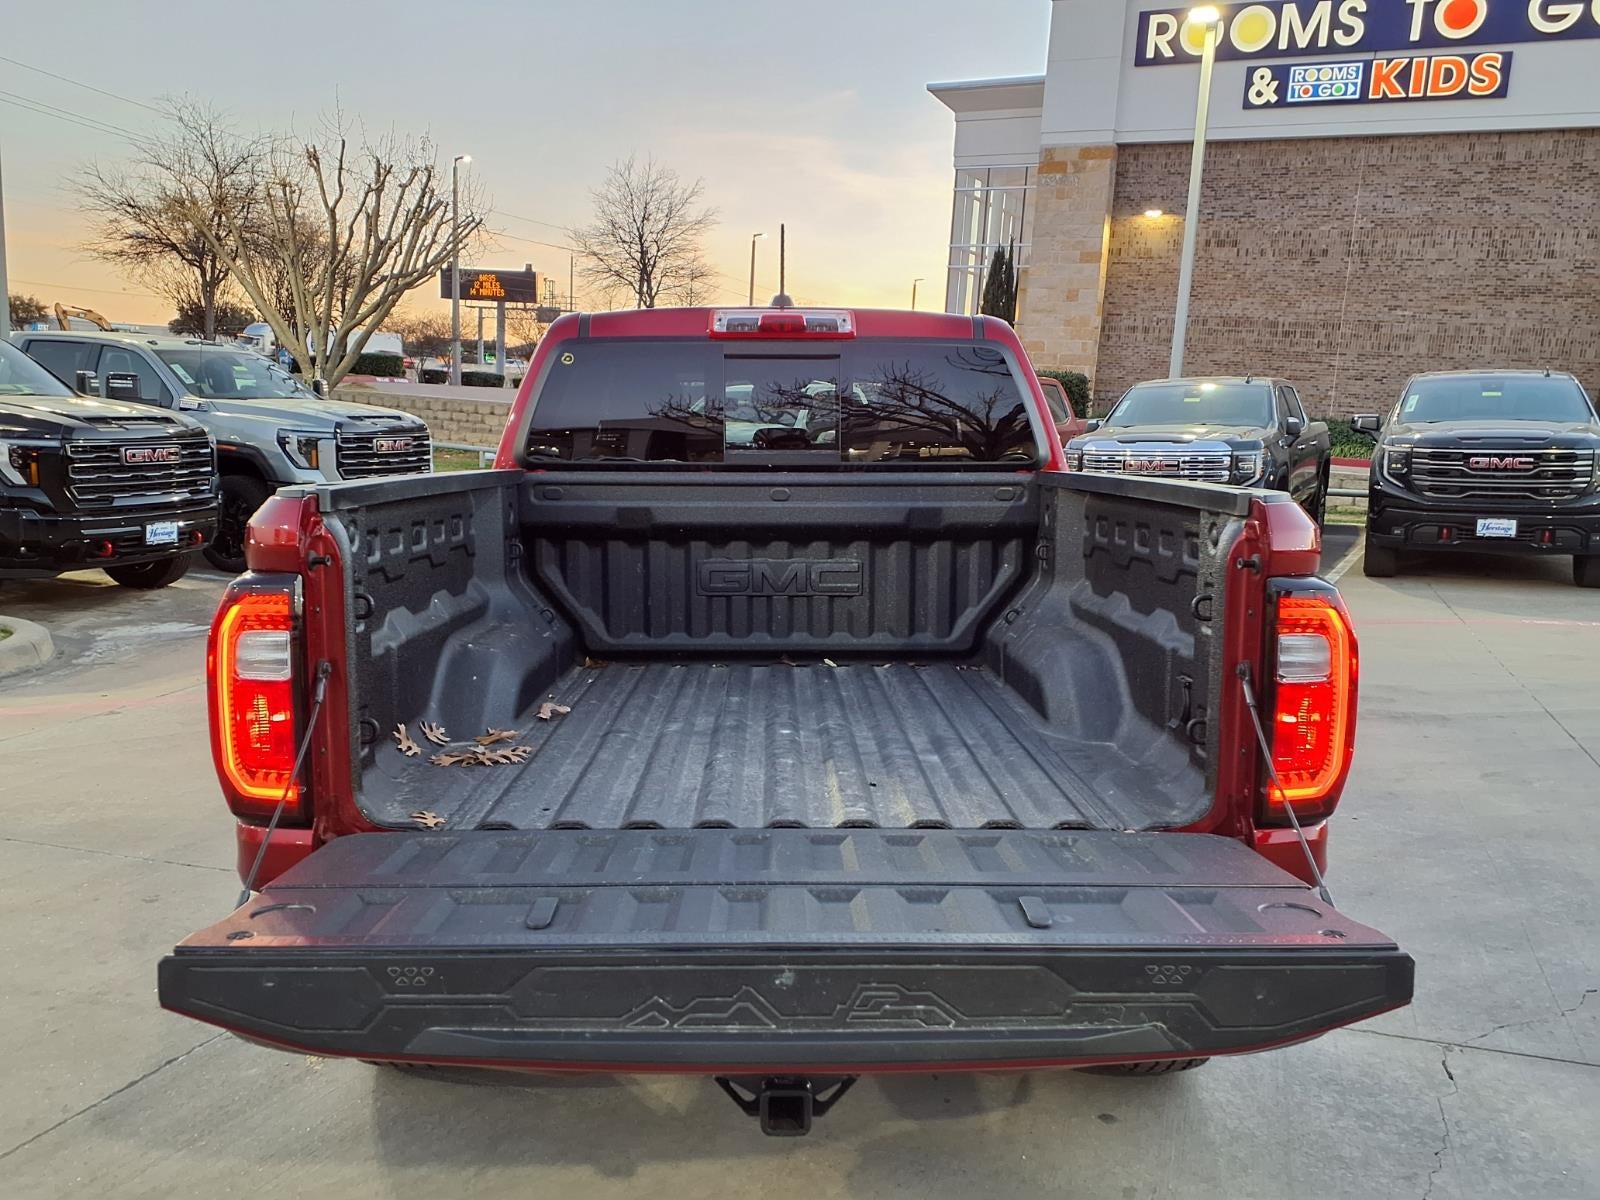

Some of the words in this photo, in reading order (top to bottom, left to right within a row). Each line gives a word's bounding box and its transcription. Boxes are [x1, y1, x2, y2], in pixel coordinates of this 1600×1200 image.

[1145, 0, 1367, 59] ROOMS
[1405, 0, 1487, 42] TO
[1528, 0, 1600, 33] G
[1248, 67, 1279, 105] &
[1368, 52, 1503, 99] KIDS
[1294, 66, 1357, 82] ROOMS
[1293, 84, 1313, 98] TO
[1318, 82, 1345, 97] GO
[479, 288, 505, 296] MINUTES
[376, 439, 413, 451] GMC
[126, 447, 180, 462] GMC
[1124, 460, 1178, 472] GMC
[1469, 457, 1534, 469] GMC
[700, 562, 860, 593] GMC
